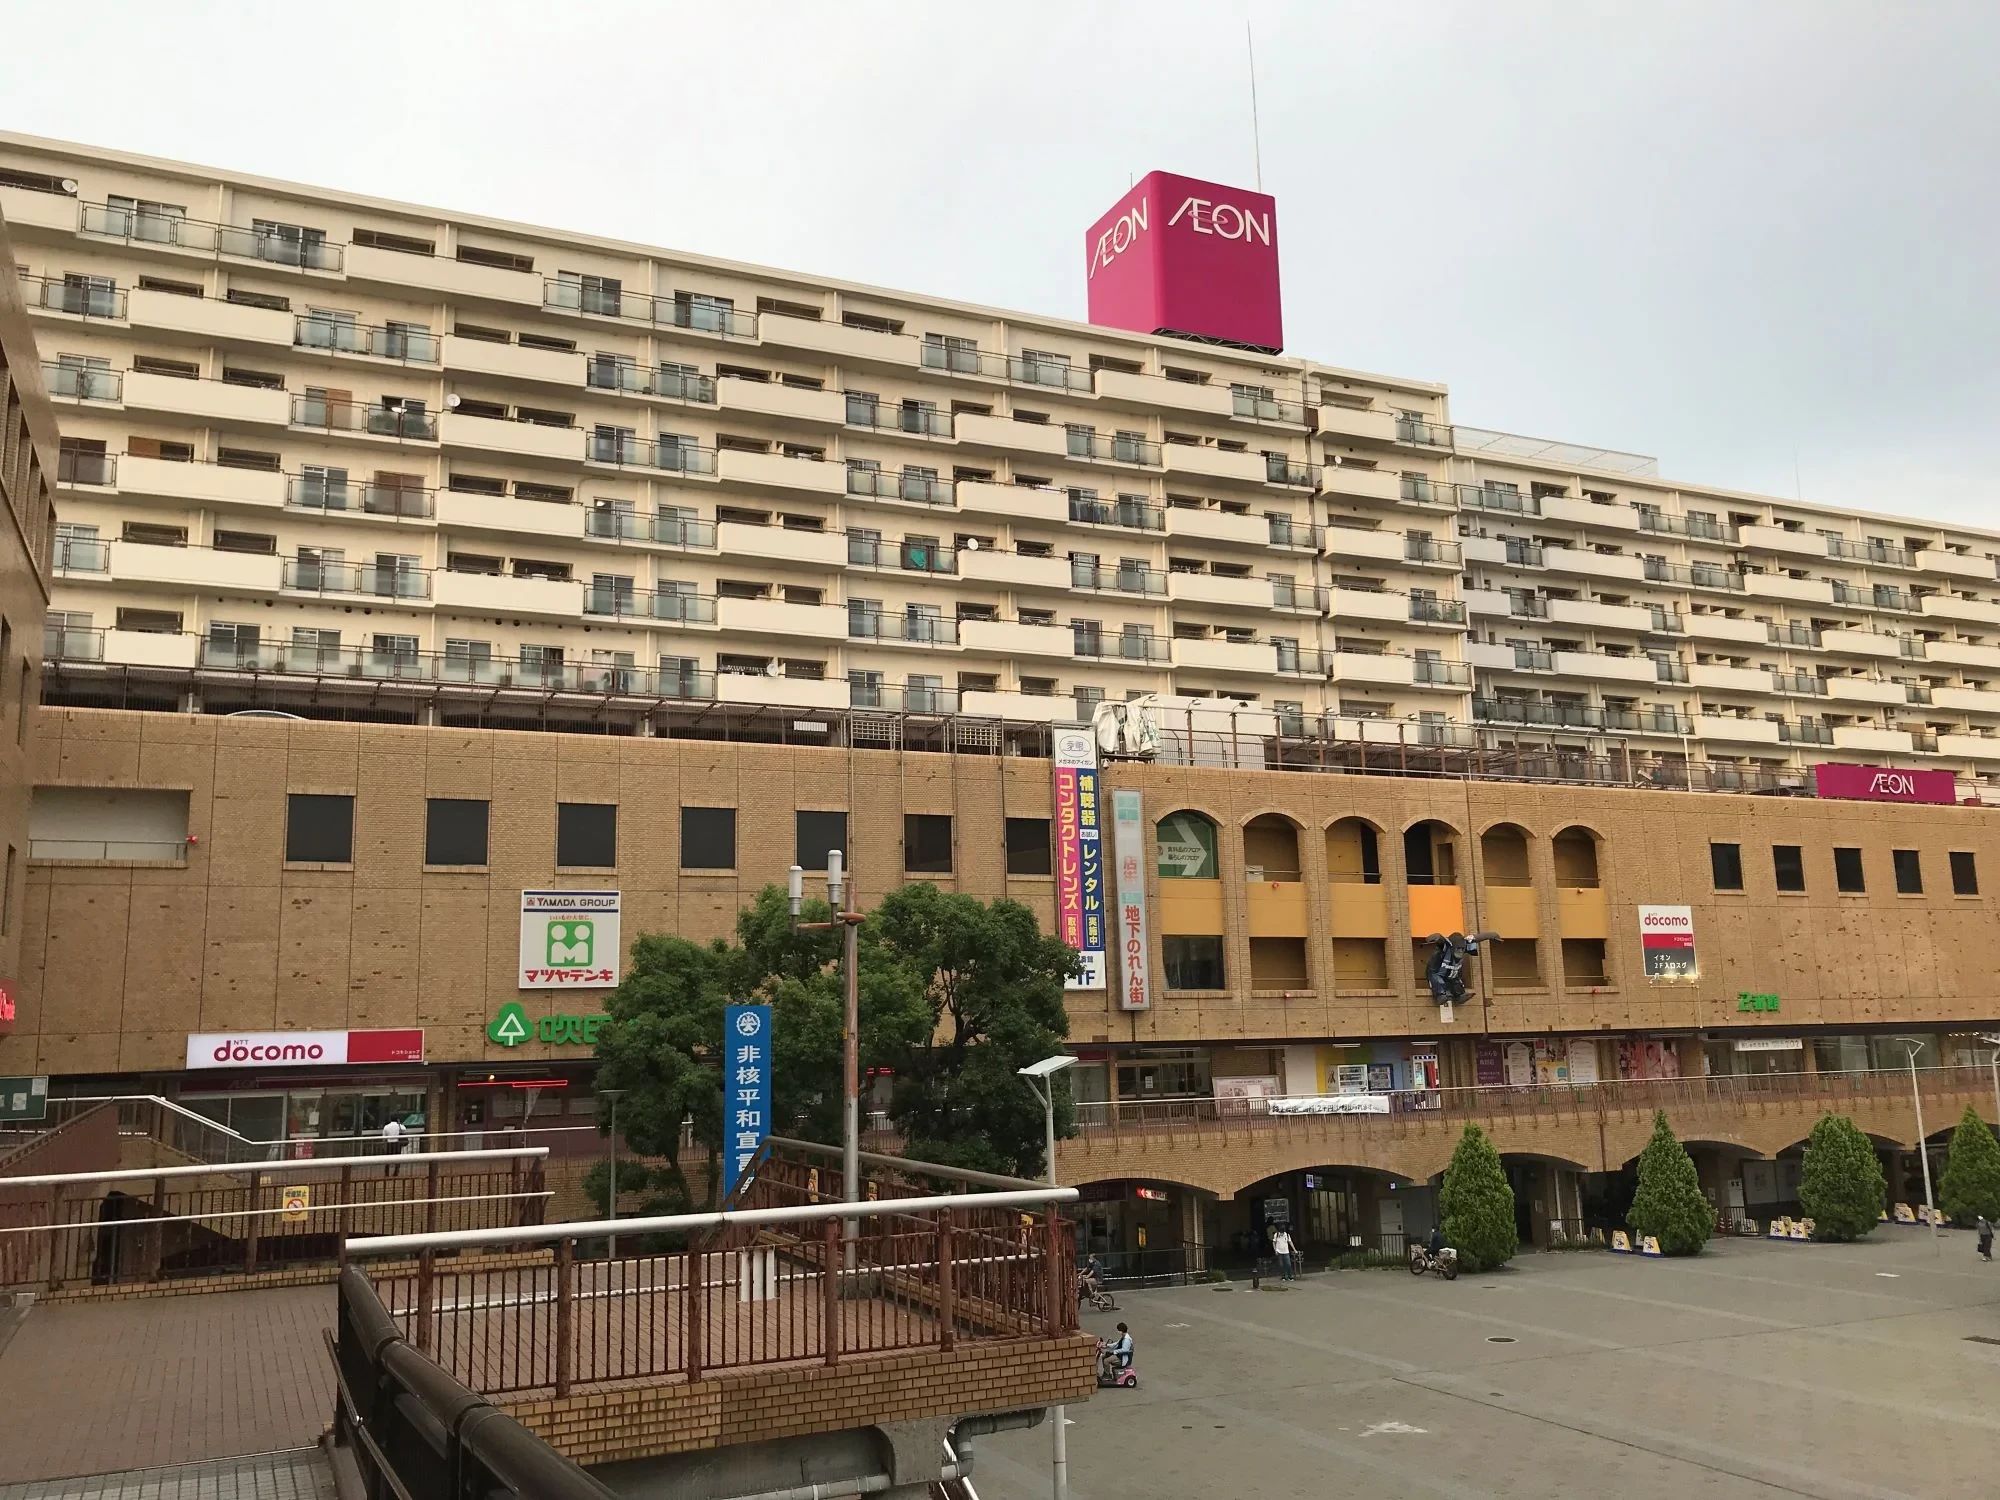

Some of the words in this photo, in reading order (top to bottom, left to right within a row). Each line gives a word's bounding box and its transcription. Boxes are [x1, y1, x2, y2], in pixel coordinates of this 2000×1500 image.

[1079, 774, 1096, 826] 補聴器
[1059, 774, 1079, 910] コンタクトレンズ
[1083, 844, 1100, 911] レンタル
[537, 897, 576, 907] YAMADA
[579, 899, 616, 907] GROUP
[1644, 912, 1689, 927] docomo
[1088, 916, 1099, 946] 実施中
[1125, 905, 1145, 1004] 地下のれん街
[524, 968, 614, 983] マツヤデンキ
[213, 1040, 324, 1062] docomo
[736, 1045, 761, 1195] 非核平和宣言
